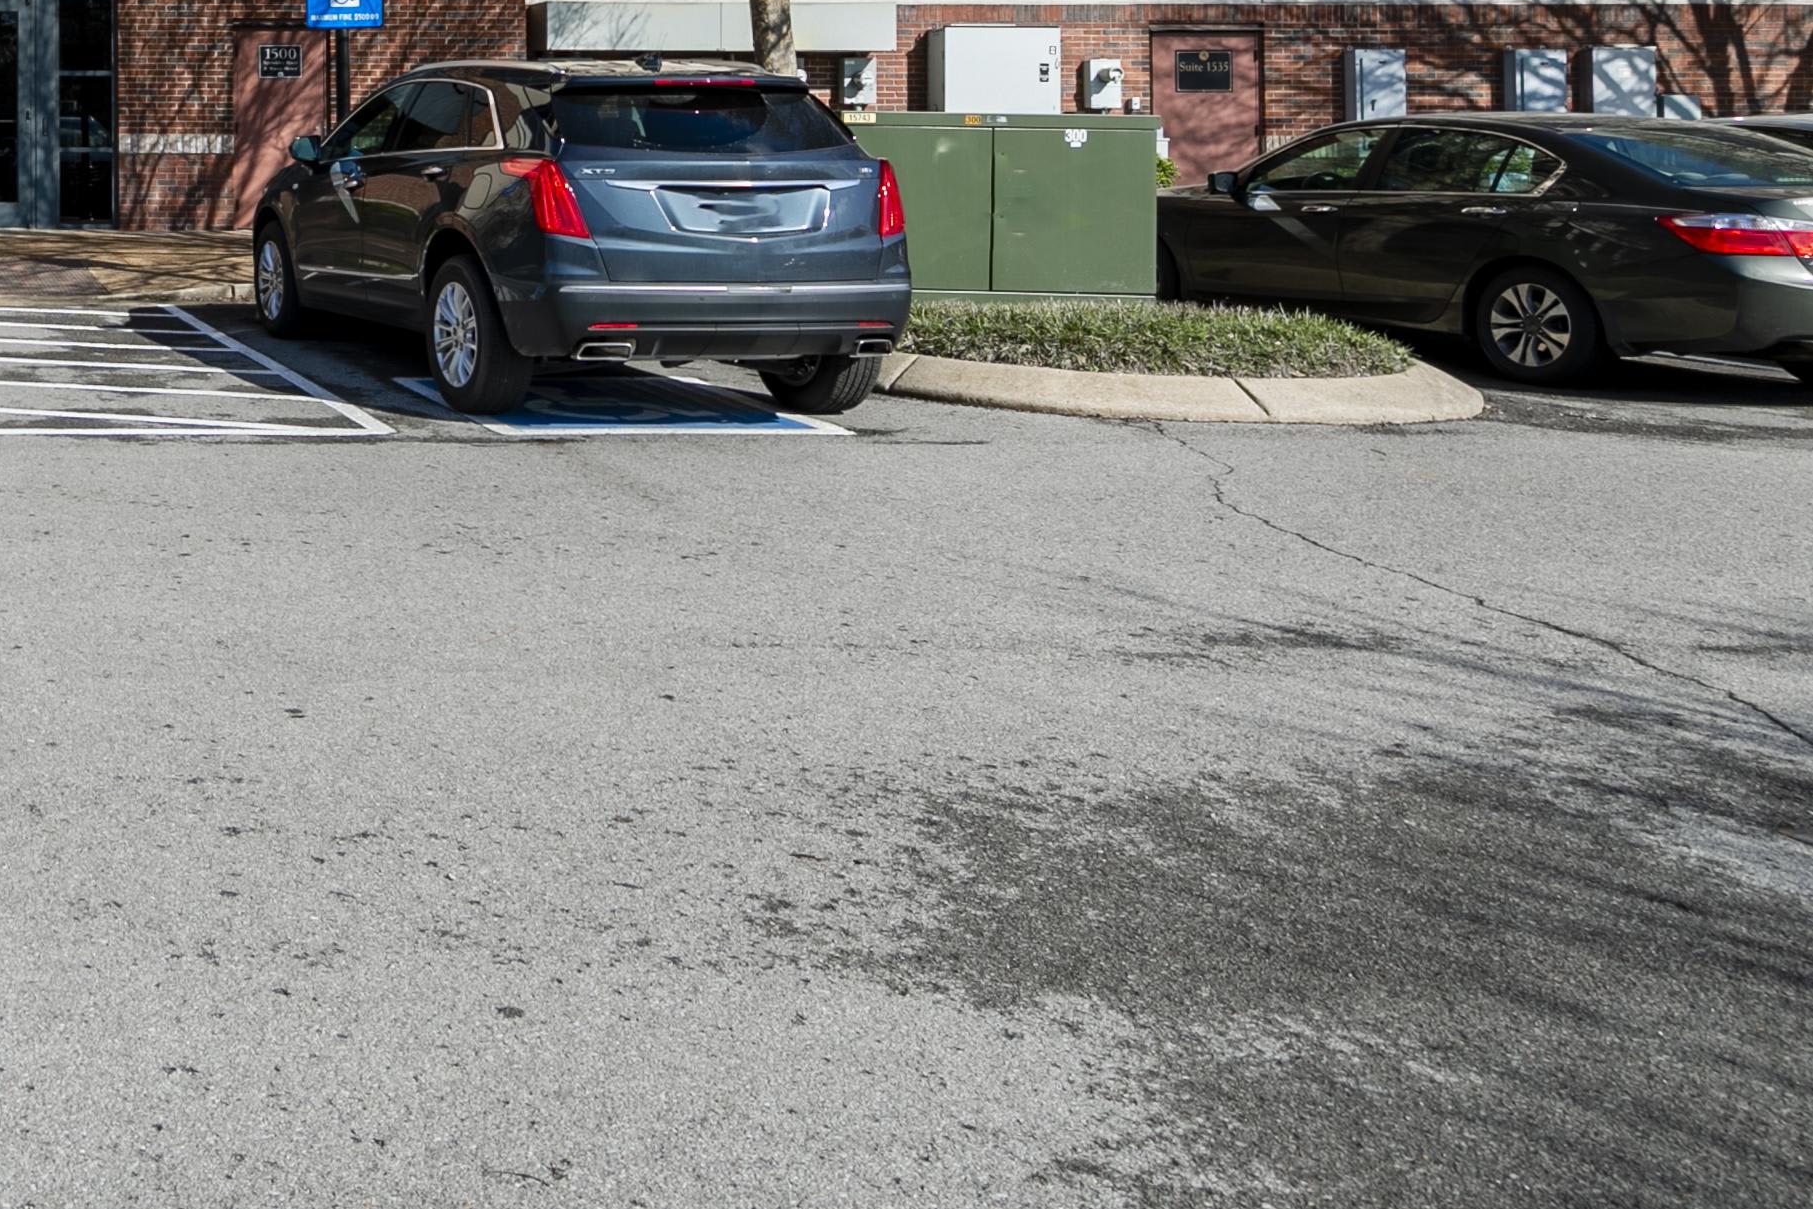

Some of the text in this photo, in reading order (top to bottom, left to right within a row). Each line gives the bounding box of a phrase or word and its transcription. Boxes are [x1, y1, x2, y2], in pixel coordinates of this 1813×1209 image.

[264, 48, 297, 60] 1500
[1179, 62, 1229, 72] Suite 1535
[1064, 128, 1088, 142] 300
